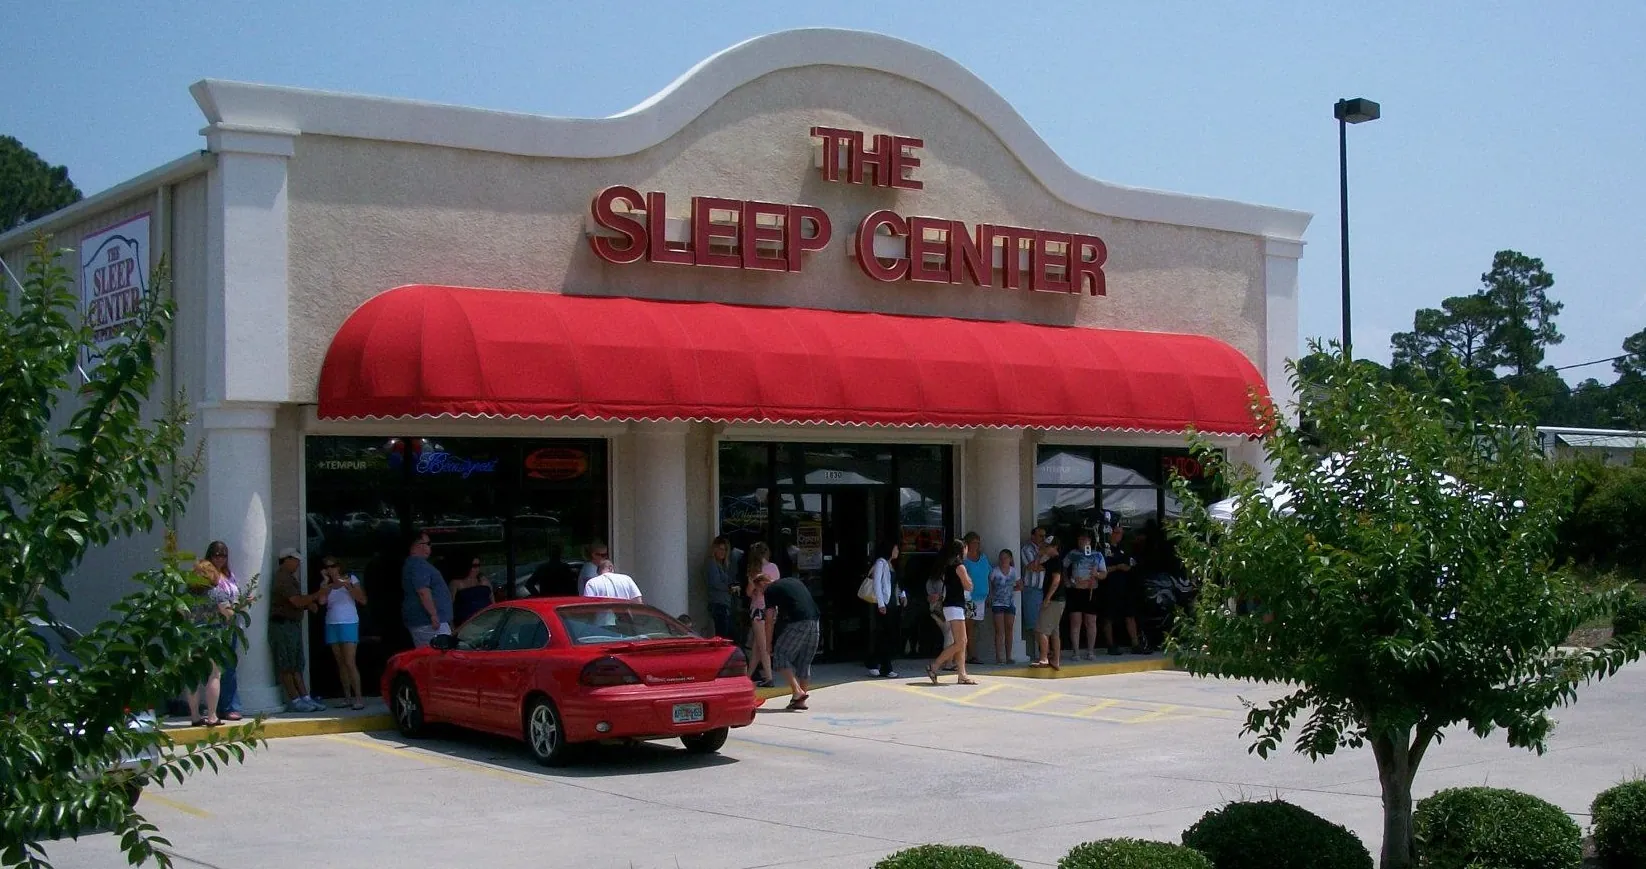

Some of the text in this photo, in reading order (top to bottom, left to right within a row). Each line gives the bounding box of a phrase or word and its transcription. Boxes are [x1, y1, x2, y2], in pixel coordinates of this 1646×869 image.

[811, 126, 924, 190] THE
[590, 184, 1108, 296] SLEEP CENTER
[94, 258, 135, 297] SLEEP
